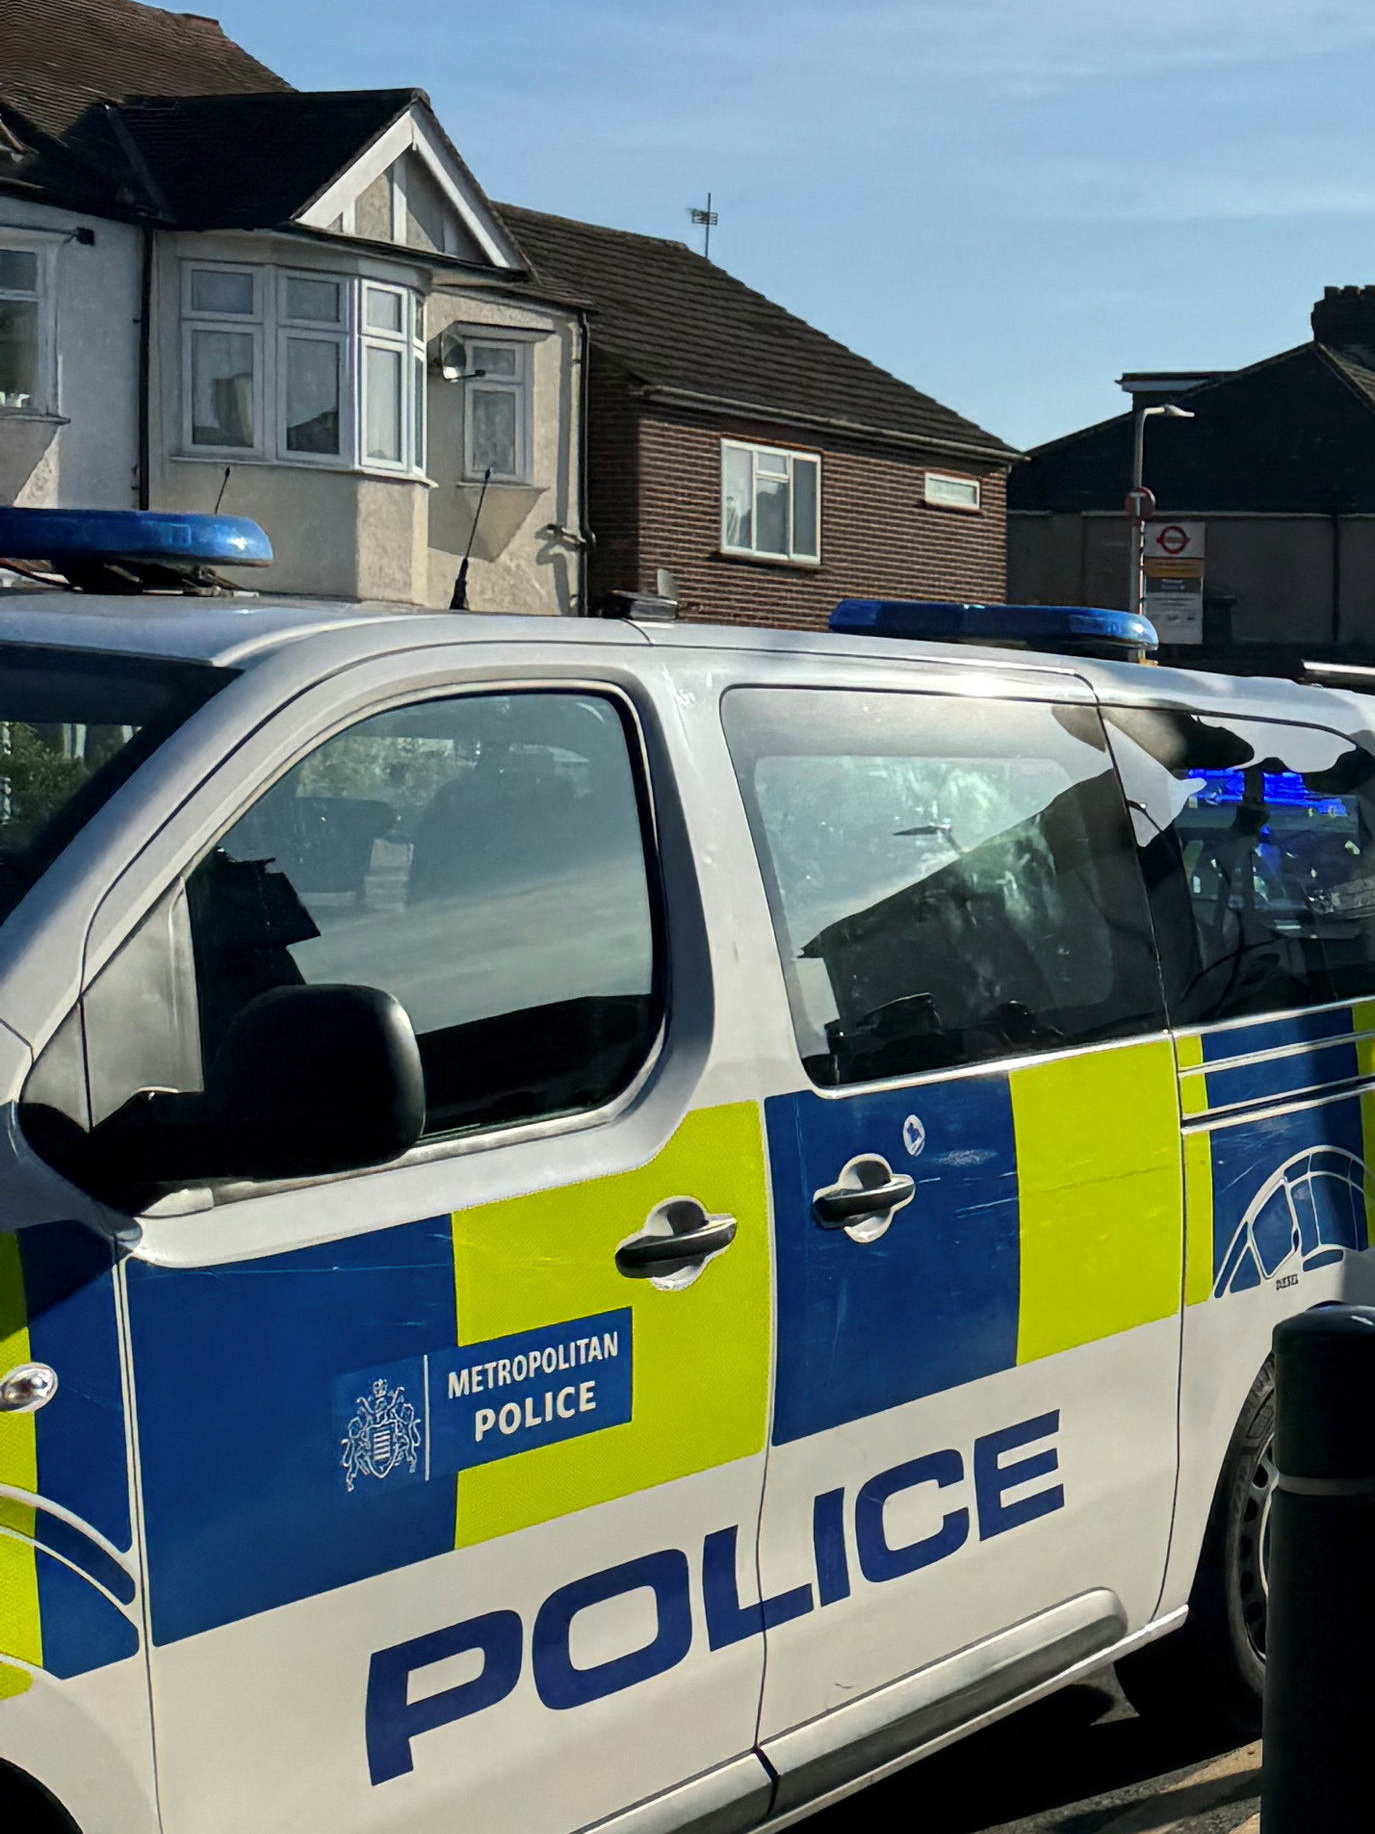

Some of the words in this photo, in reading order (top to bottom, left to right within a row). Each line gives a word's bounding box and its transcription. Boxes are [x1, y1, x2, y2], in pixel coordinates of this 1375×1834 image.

[447, 1331, 618, 1400] METROPOLITAN
[474, 1380, 597, 1443] POLICE
[364, 1408, 1067, 1787] POLICE
